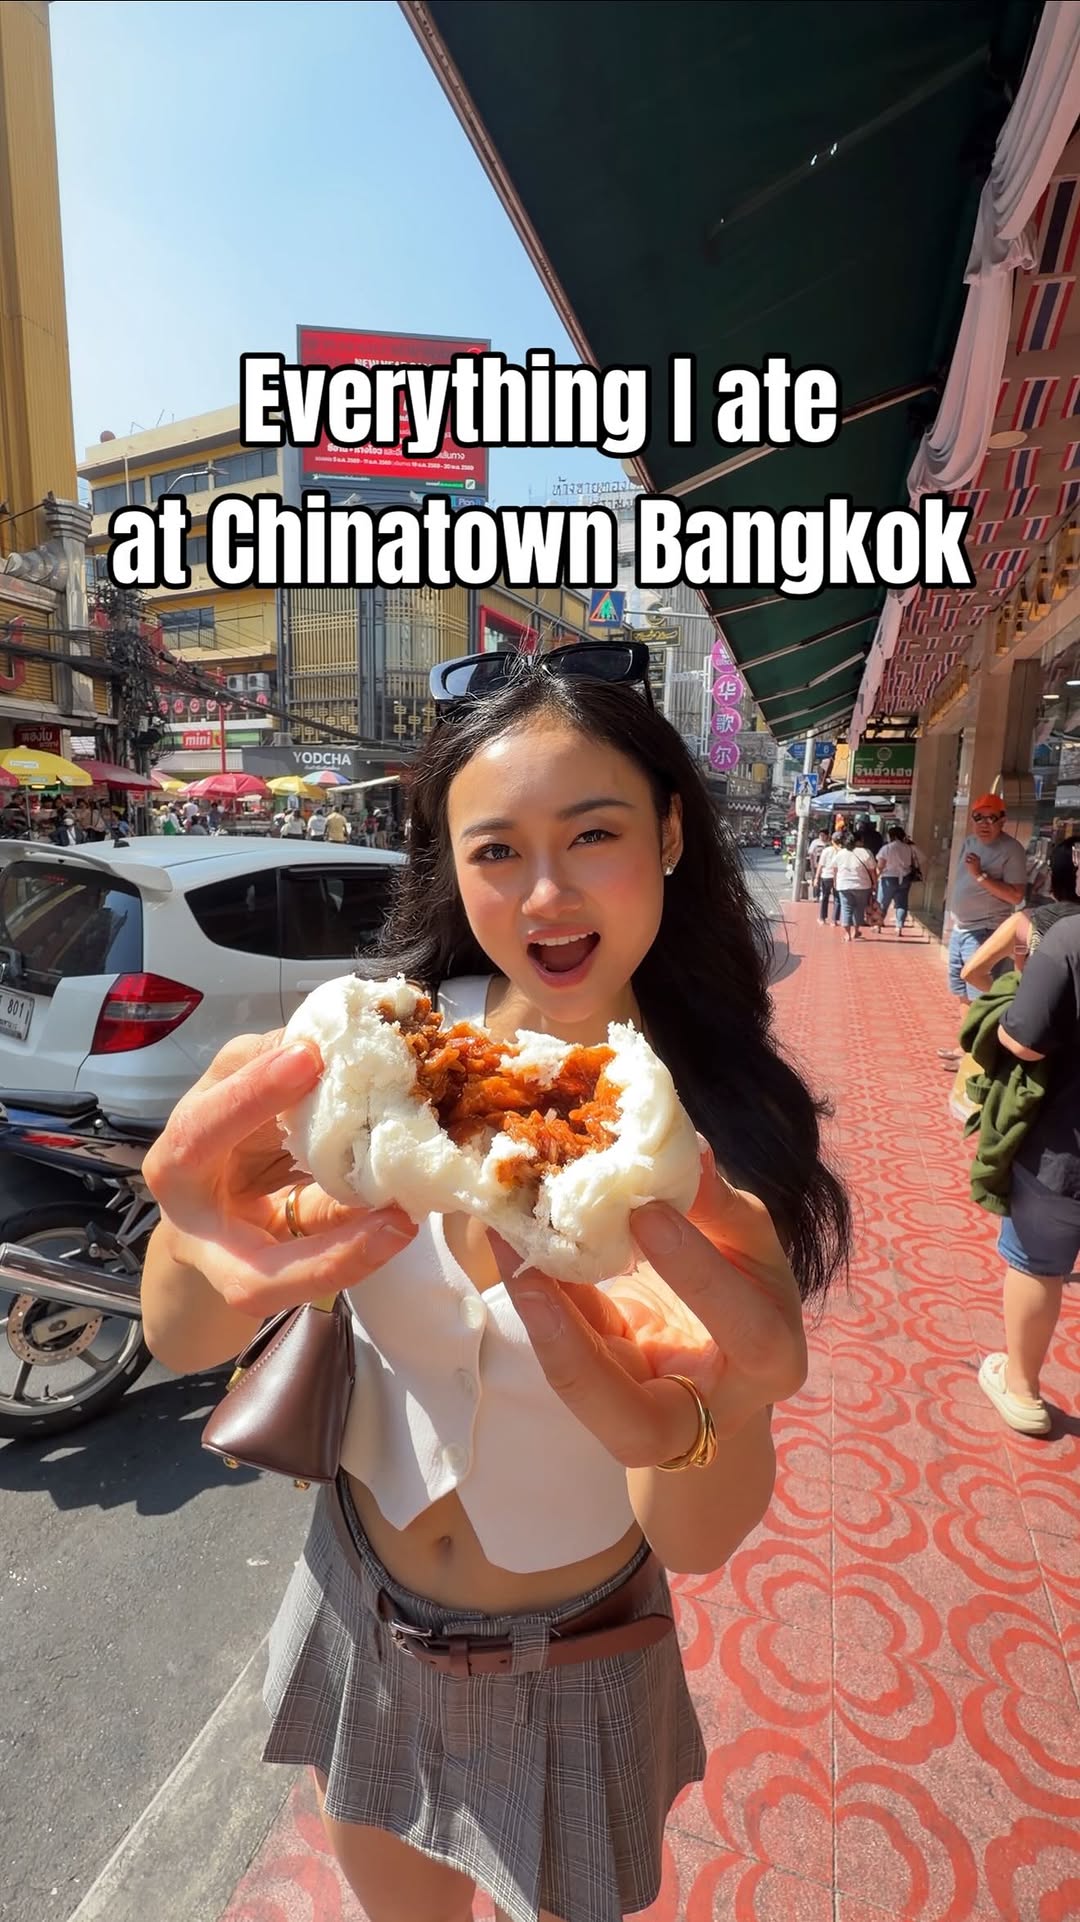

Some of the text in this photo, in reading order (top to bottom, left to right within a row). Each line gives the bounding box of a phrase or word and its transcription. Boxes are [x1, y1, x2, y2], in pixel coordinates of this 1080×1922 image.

[715, 680, 737, 765] 华歌尔
[185, 731, 212, 746] mini
[292, 751, 352, 766] YODCHA
[7, 998, 25, 1019] 801
